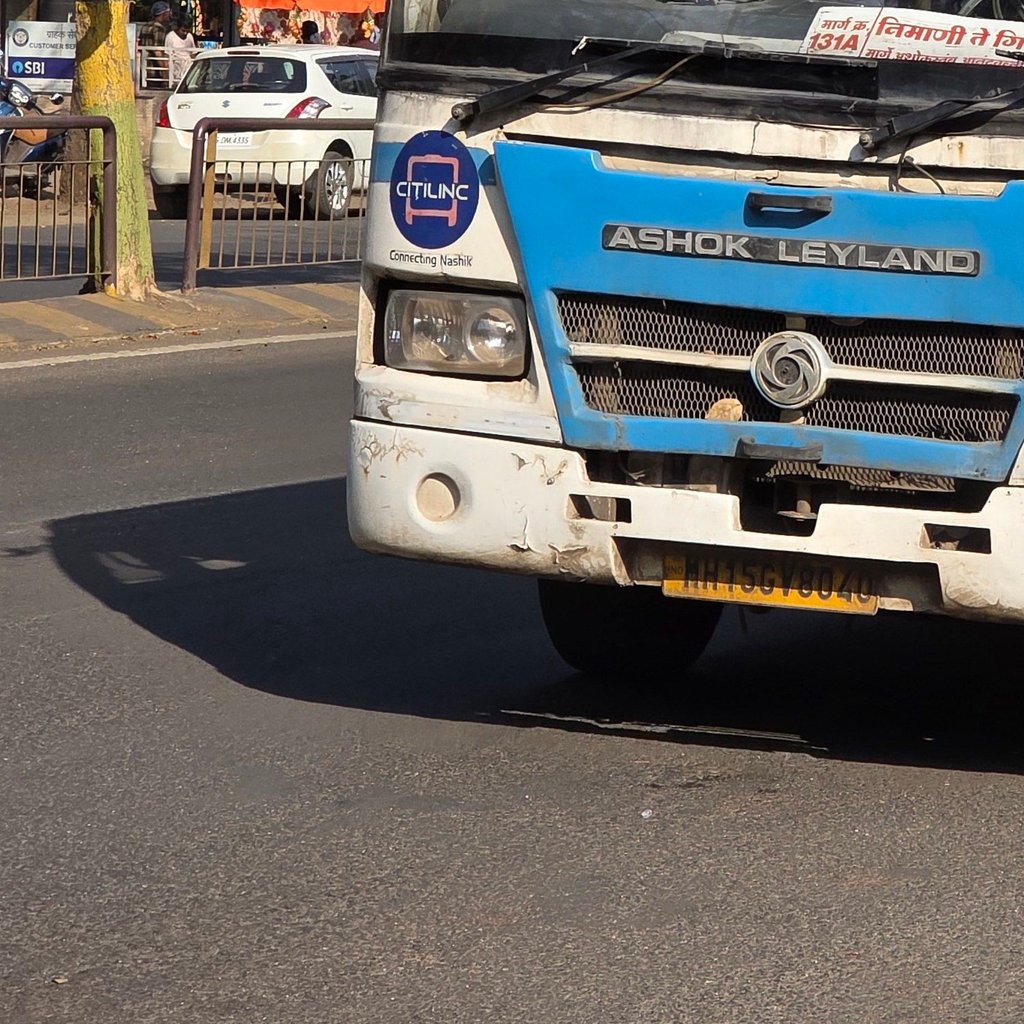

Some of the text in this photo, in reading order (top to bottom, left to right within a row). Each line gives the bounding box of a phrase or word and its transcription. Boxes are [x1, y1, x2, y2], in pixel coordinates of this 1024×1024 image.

[821, 17, 853, 31] मार्ग
[874, 16, 967, 46] निमाणी
[969, 27, 991, 46] ते
[28, 42, 64, 51] CUSTOMER
[807, 32, 860, 52] 131A
[24, 60, 46, 75] SBI
[395, 179, 470, 203] CITILINC
[389, 249, 474, 268] Connecting Nashik
[606, 225, 976, 275] ASHOK LEYLAND
